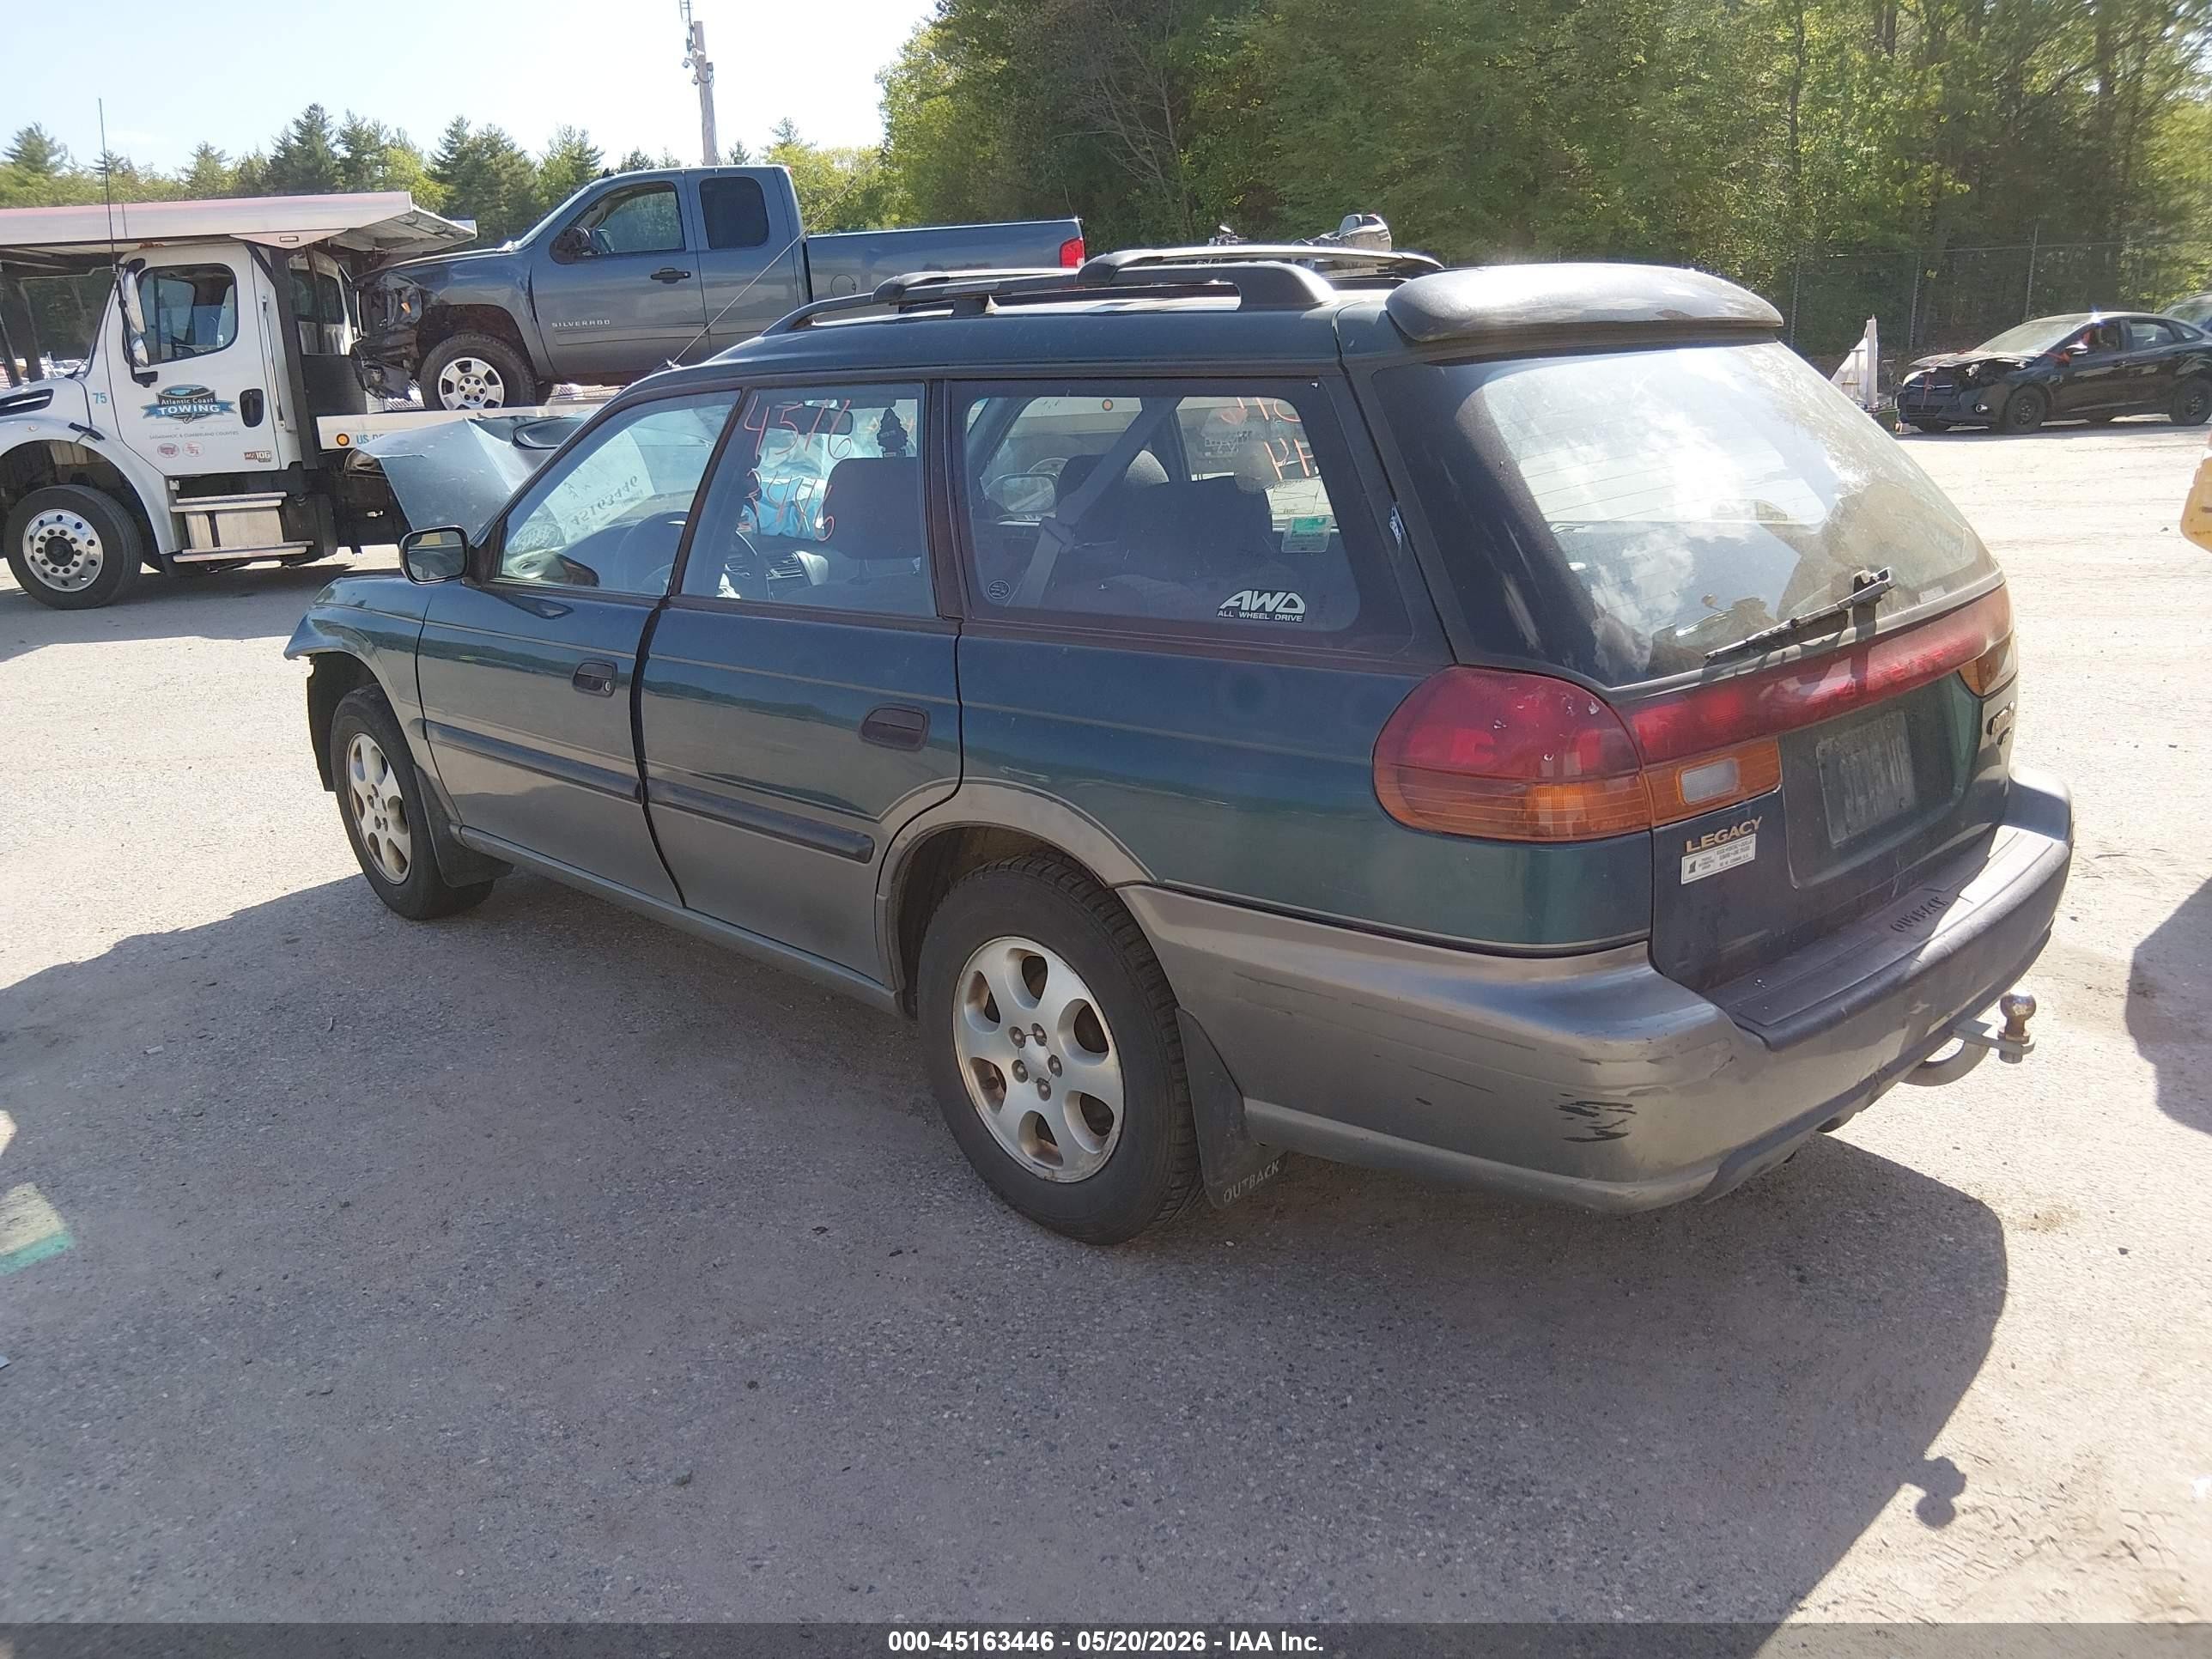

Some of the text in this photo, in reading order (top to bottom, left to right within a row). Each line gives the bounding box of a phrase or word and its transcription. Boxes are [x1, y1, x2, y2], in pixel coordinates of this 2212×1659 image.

[93, 392, 107, 404] 75
[157, 404, 220, 415] TOWING
[744, 394, 852, 460] 4516
[1219, 590, 1306, 614] AWD
[1238, 611, 1271, 620] WHEEL
[1274, 613, 1304, 622] DRIVE
[1686, 816, 1763, 853] LEGACY
[1223, 1159, 1279, 1203] OUTBACK
